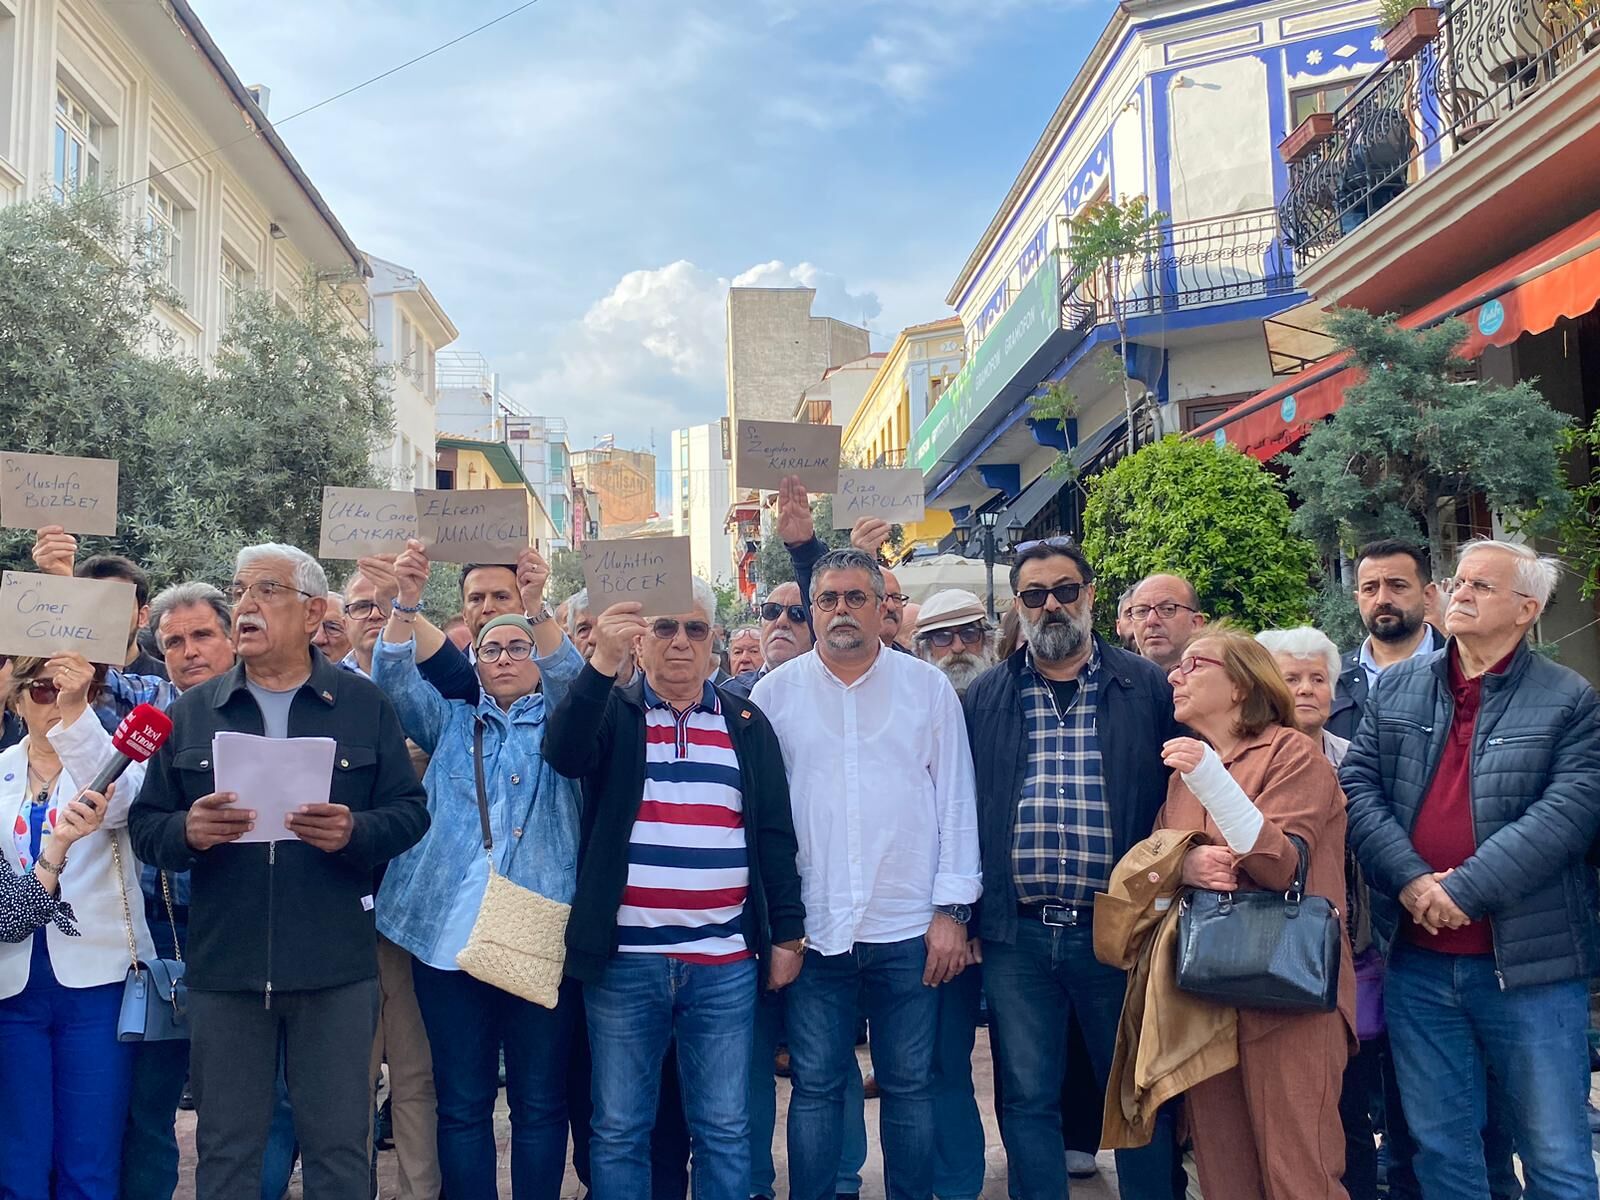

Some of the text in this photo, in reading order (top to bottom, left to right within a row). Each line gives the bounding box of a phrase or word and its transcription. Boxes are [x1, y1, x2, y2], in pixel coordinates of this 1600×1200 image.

[15, 472, 80, 497] Mustafa
[328, 501, 371, 520] Utku
[423, 498, 487, 517] Ekrem
[847, 493, 924, 512] AKPOLAT
[594, 551, 664, 574] Muhittin
[16, 581, 70, 615] Ömer
[26, 617, 100, 641] GÜNEL
